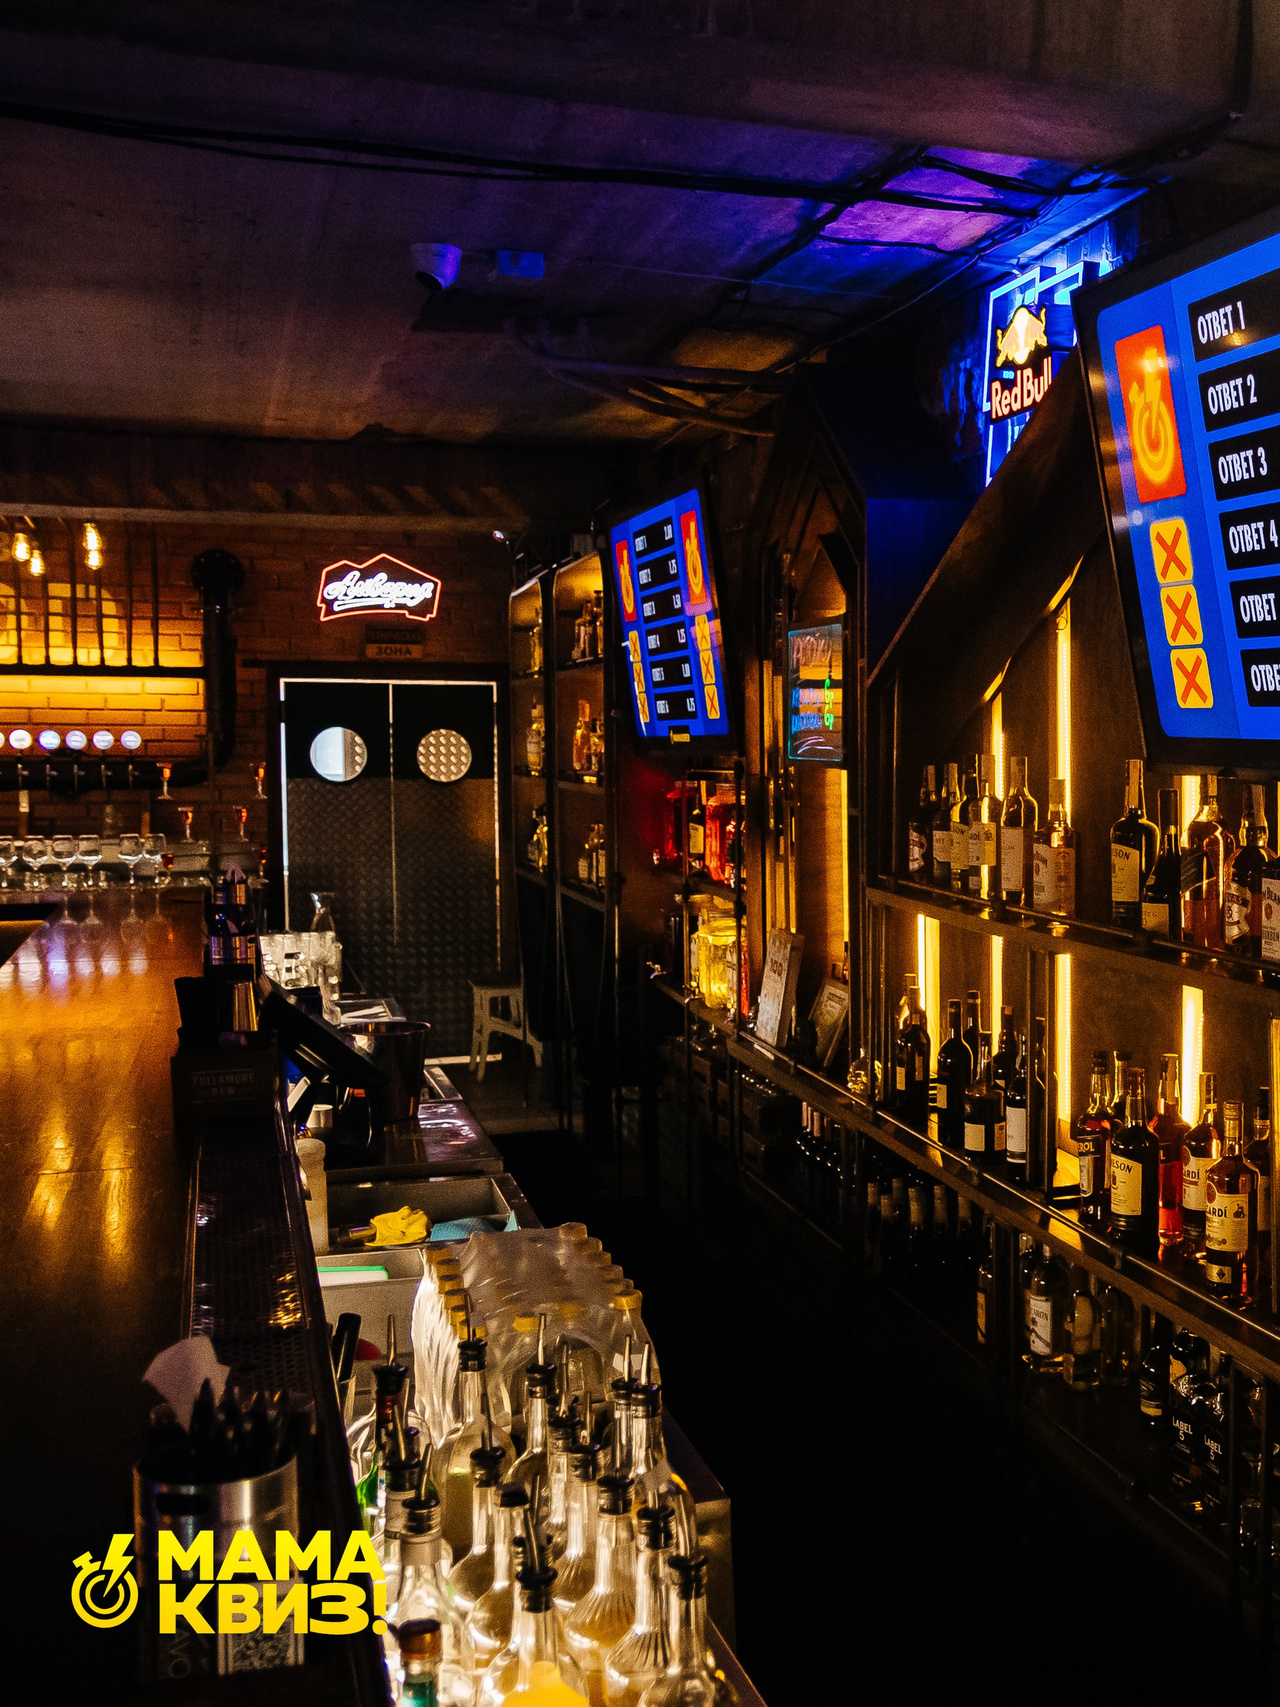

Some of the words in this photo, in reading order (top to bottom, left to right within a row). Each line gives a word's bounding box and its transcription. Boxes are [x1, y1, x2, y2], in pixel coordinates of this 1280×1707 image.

[1197, 304, 1234, 344] ОТВЕТ
[1236, 300, 1246, 330] 1
[991, 369, 1022, 420] Red
[1022, 356, 1053, 408] Bull
[1207, 377, 1244, 415] ОТВЕТ
[1246, 373, 1258, 404] 2
[1218, 449, 1254, 485] ОТВЕТ
[1257, 446, 1268, 476] 3
[1228, 521, 1266, 554] ОТВЕТ
[1269, 519, 1279, 548] 4
[1239, 593, 1277, 623] ОТВЕТ
[376, 645, 412, 656] ЗОНА
[1172, 1416, 1193, 1435] LABEL
[1204, 1434, 1222, 1455] LABEL
